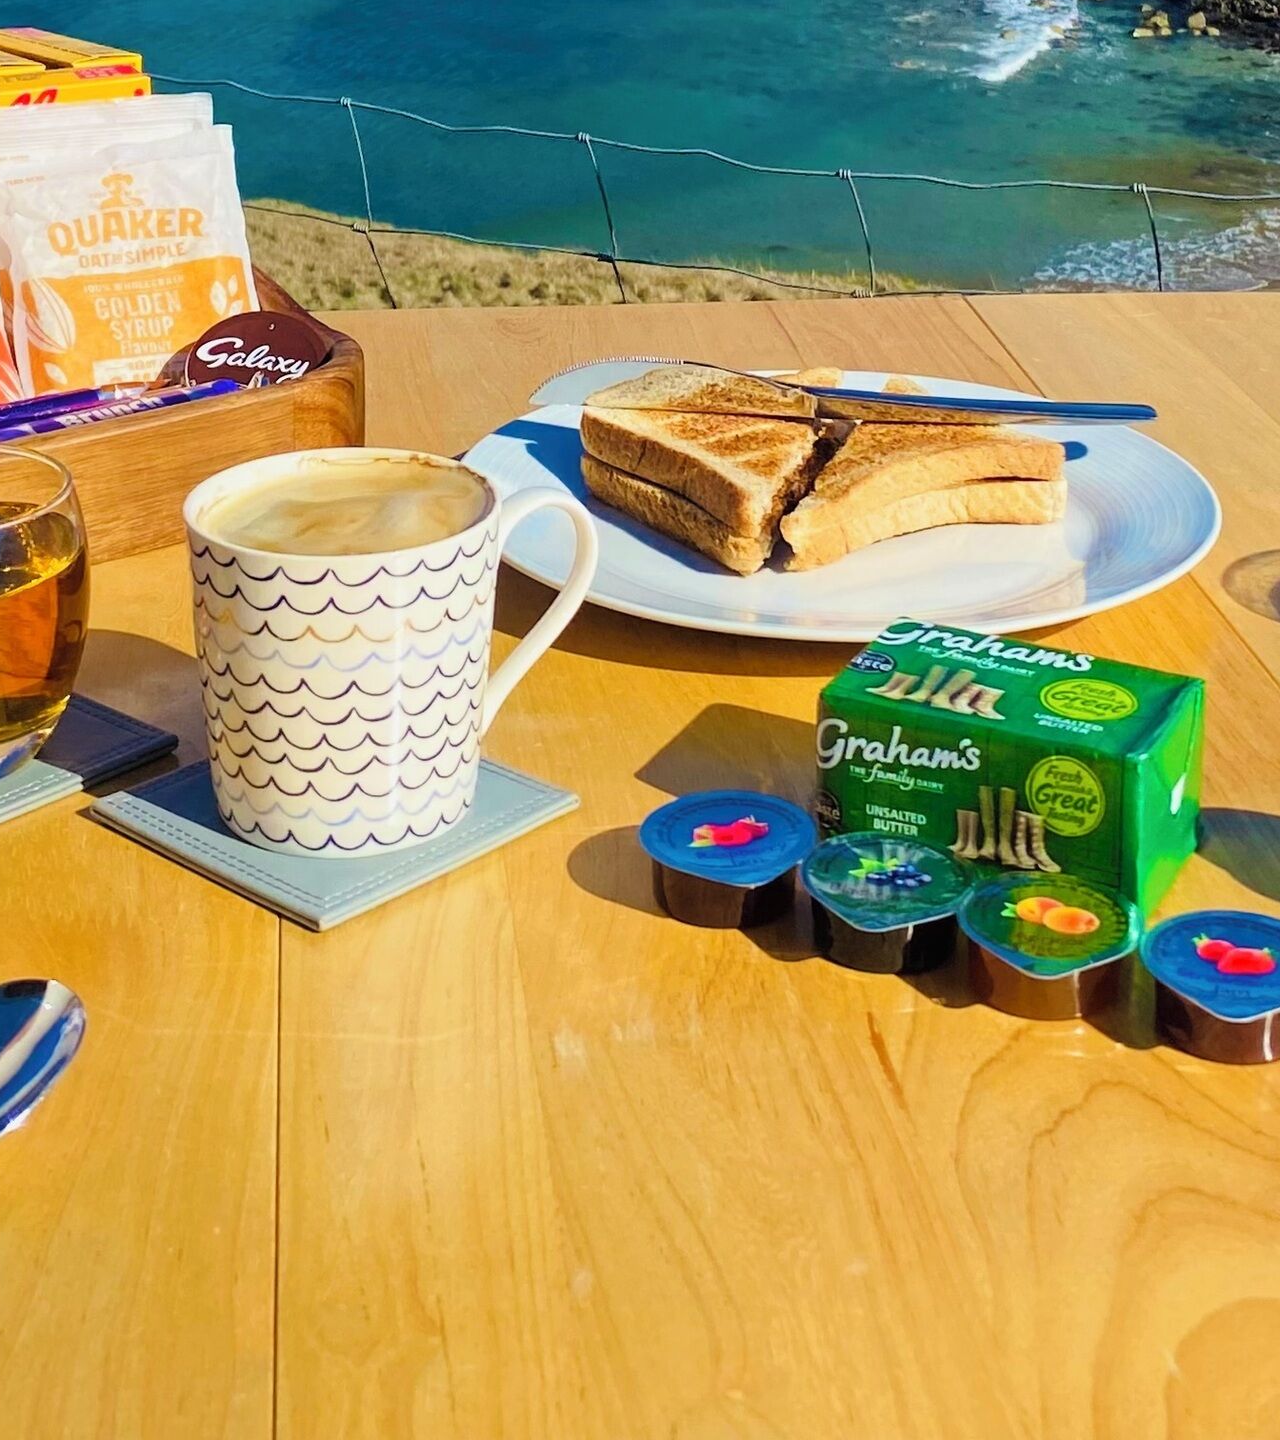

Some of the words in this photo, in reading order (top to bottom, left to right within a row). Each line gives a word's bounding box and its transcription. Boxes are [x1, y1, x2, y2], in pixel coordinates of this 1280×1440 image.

[47, 208, 205, 256] QUAKER
[79, 254, 111, 269] OAT
[125, 242, 188, 265] SIMPLE
[94, 290, 183, 321] GOLDEN
[109, 316, 175, 342] SYRUP
[120, 340, 172, 356] Flavour
[196, 336, 310, 384] Galaxy
[876, 618, 1096, 672] Graham's
[1051, 690, 1128, 713] Great
[816, 718, 982, 772] Graham's
[849, 764, 867, 776] THE
[862, 762, 916, 791] family
[915, 778, 945, 791] DAIRY
[1044, 764, 1084, 785] Fresh
[1034, 782, 1098, 814] Great
[865, 803, 928, 826] UNSALTED
[873, 817, 919, 837] BUTTER
